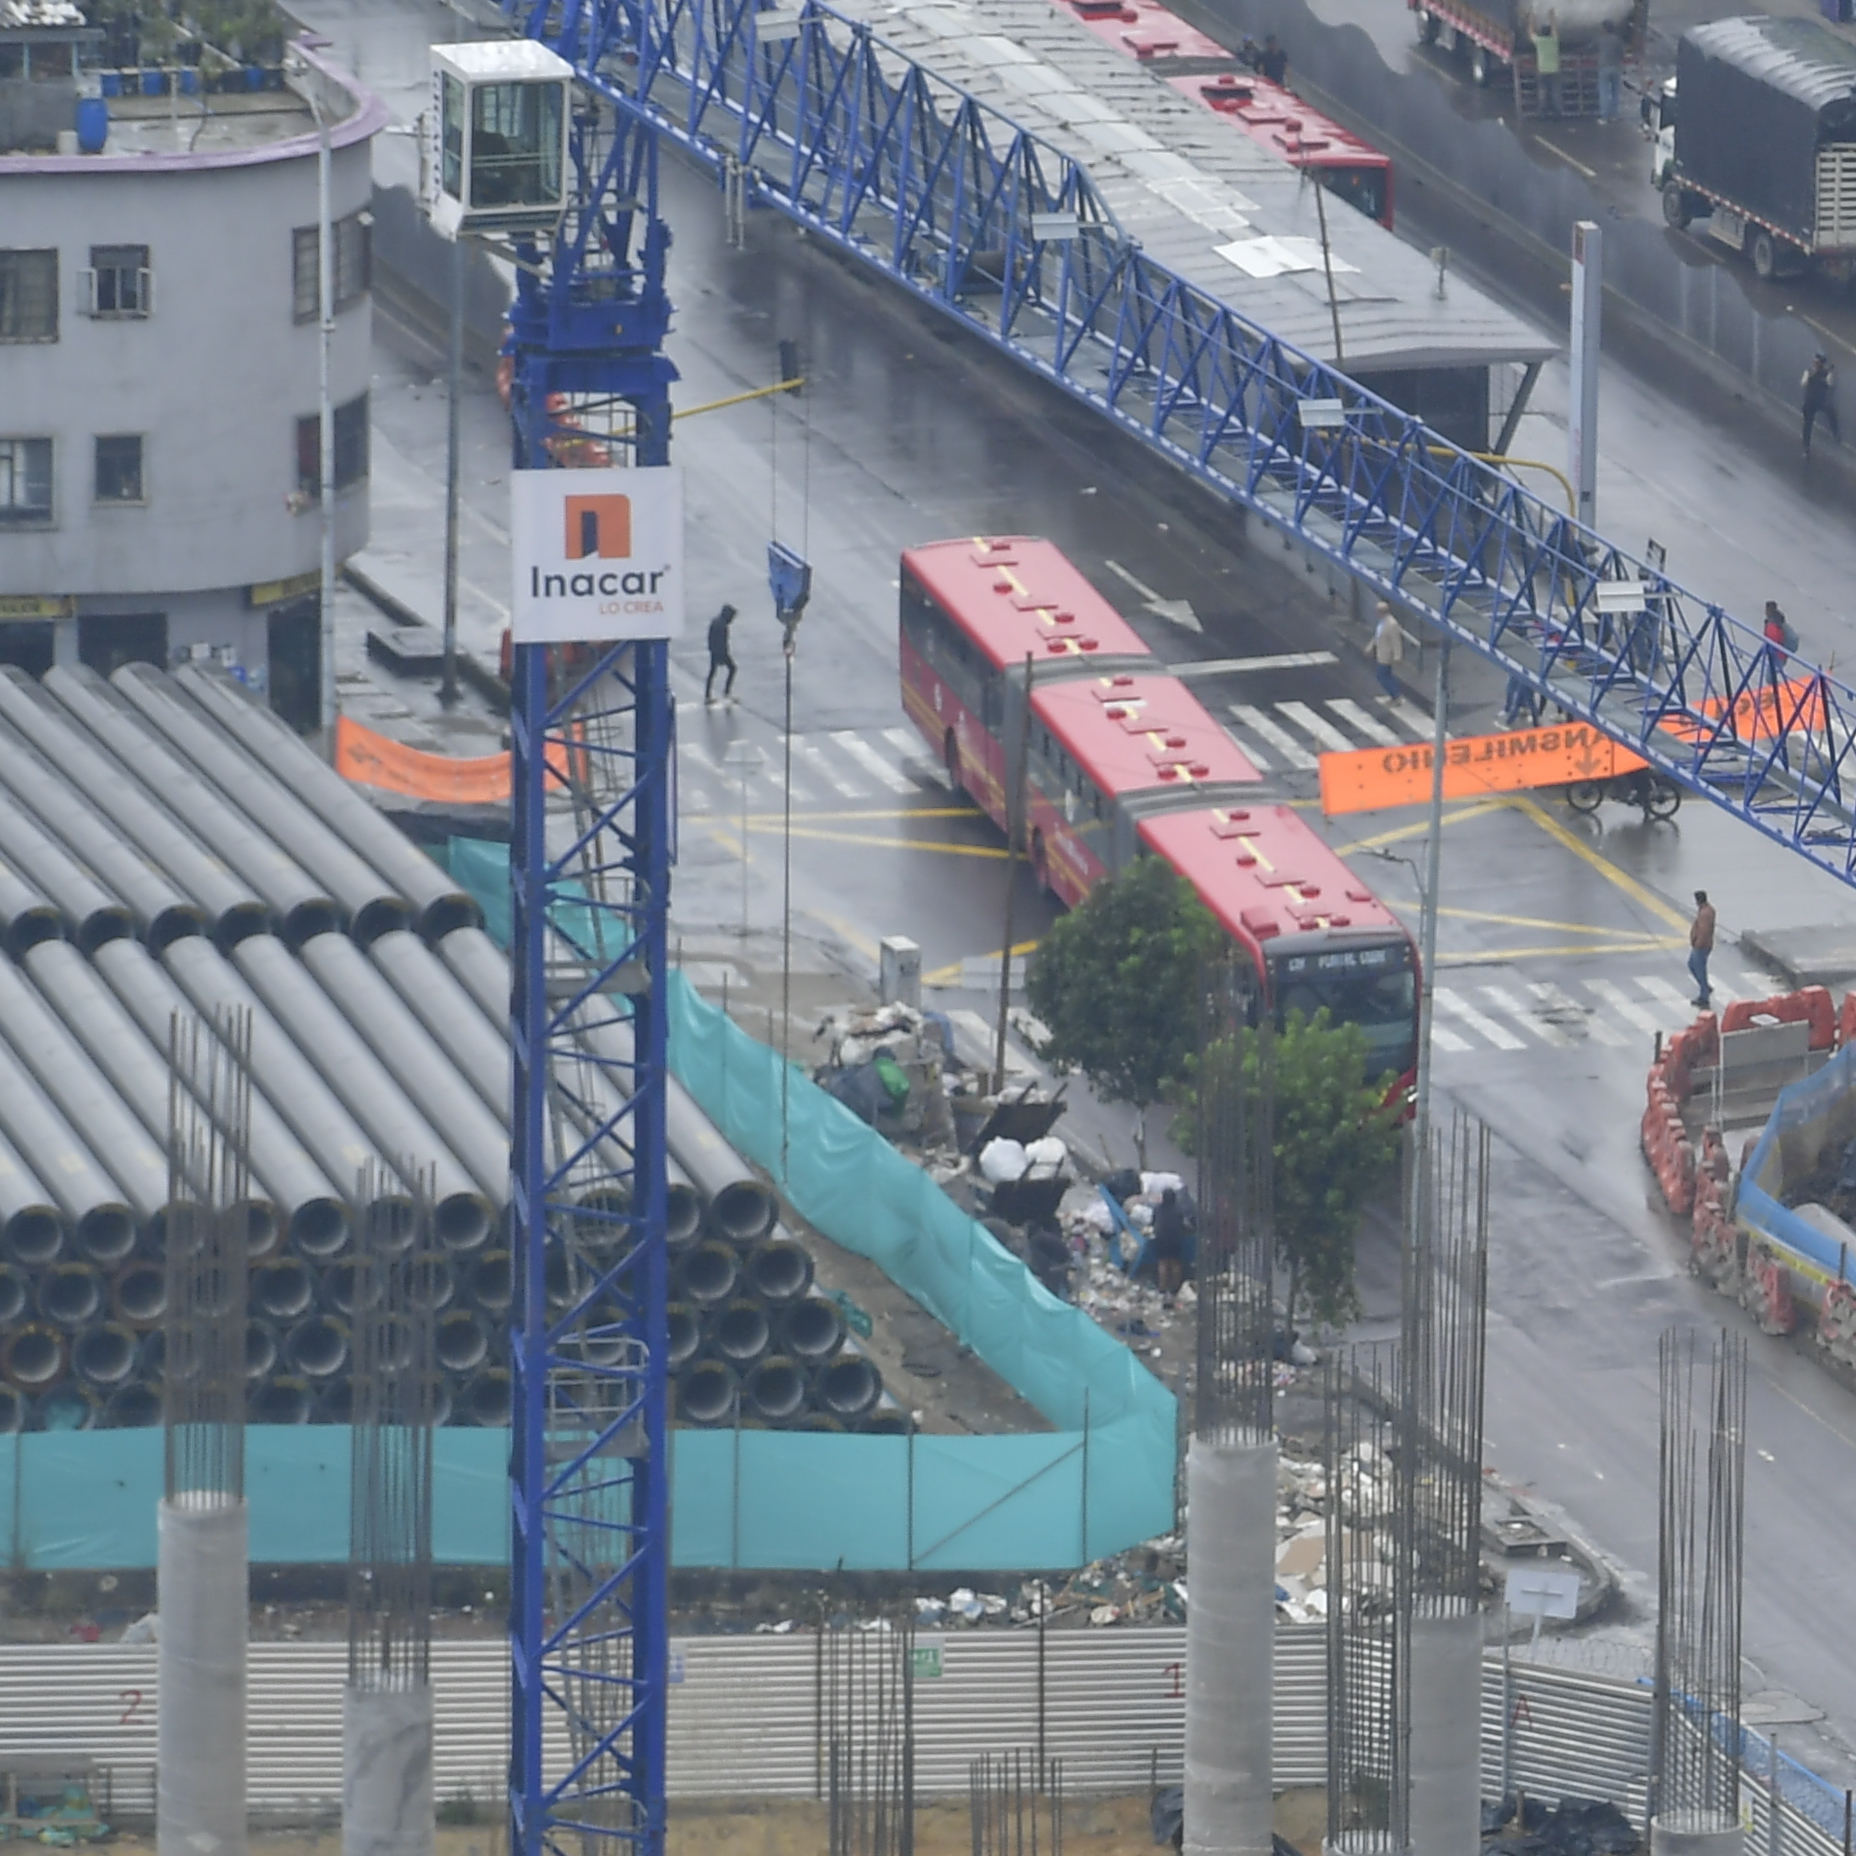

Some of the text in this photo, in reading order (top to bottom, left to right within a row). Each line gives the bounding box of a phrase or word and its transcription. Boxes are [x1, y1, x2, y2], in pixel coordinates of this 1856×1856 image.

[532, 566, 664, 597] Inacar
[600, 601, 664, 614] LO CREA
[119, 1689, 144, 1725] 2
